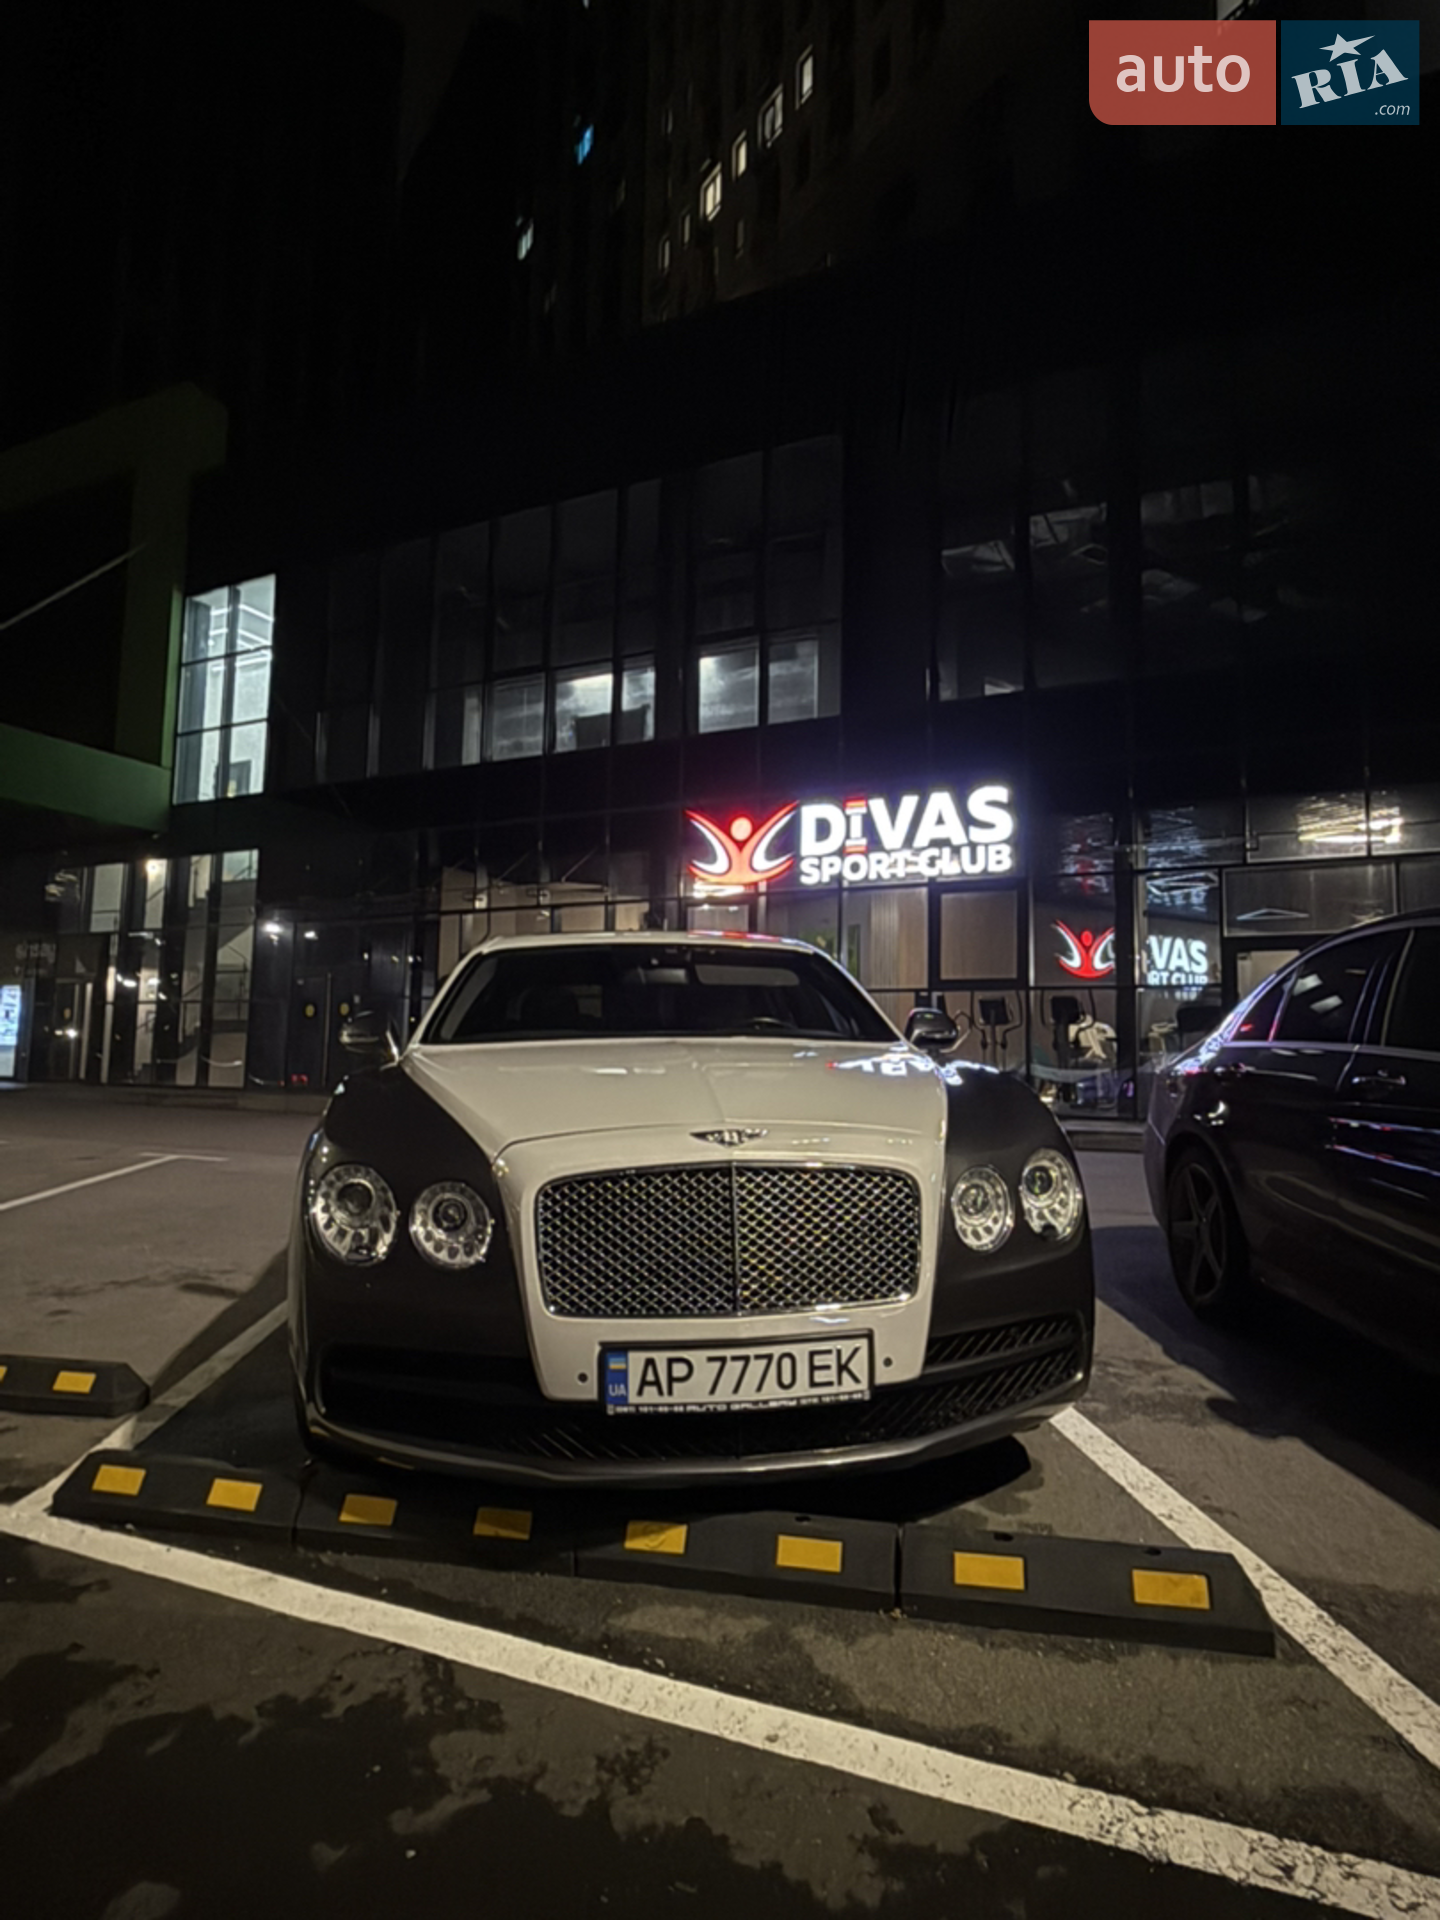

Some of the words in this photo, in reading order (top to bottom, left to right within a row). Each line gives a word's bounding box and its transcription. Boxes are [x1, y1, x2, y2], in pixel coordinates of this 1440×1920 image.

[800, 849, 911, 885] SPORT
[919, 843, 1013, 877] CLUB
[1147, 935, 1209, 974] VAS
[1147, 970, 1170, 986] RT
[609, 1384, 627, 1397] UA
[636, 1356, 694, 1398] AP
[706, 1352, 797, 1396] 7770
[808, 1346, 862, 1389] EK
